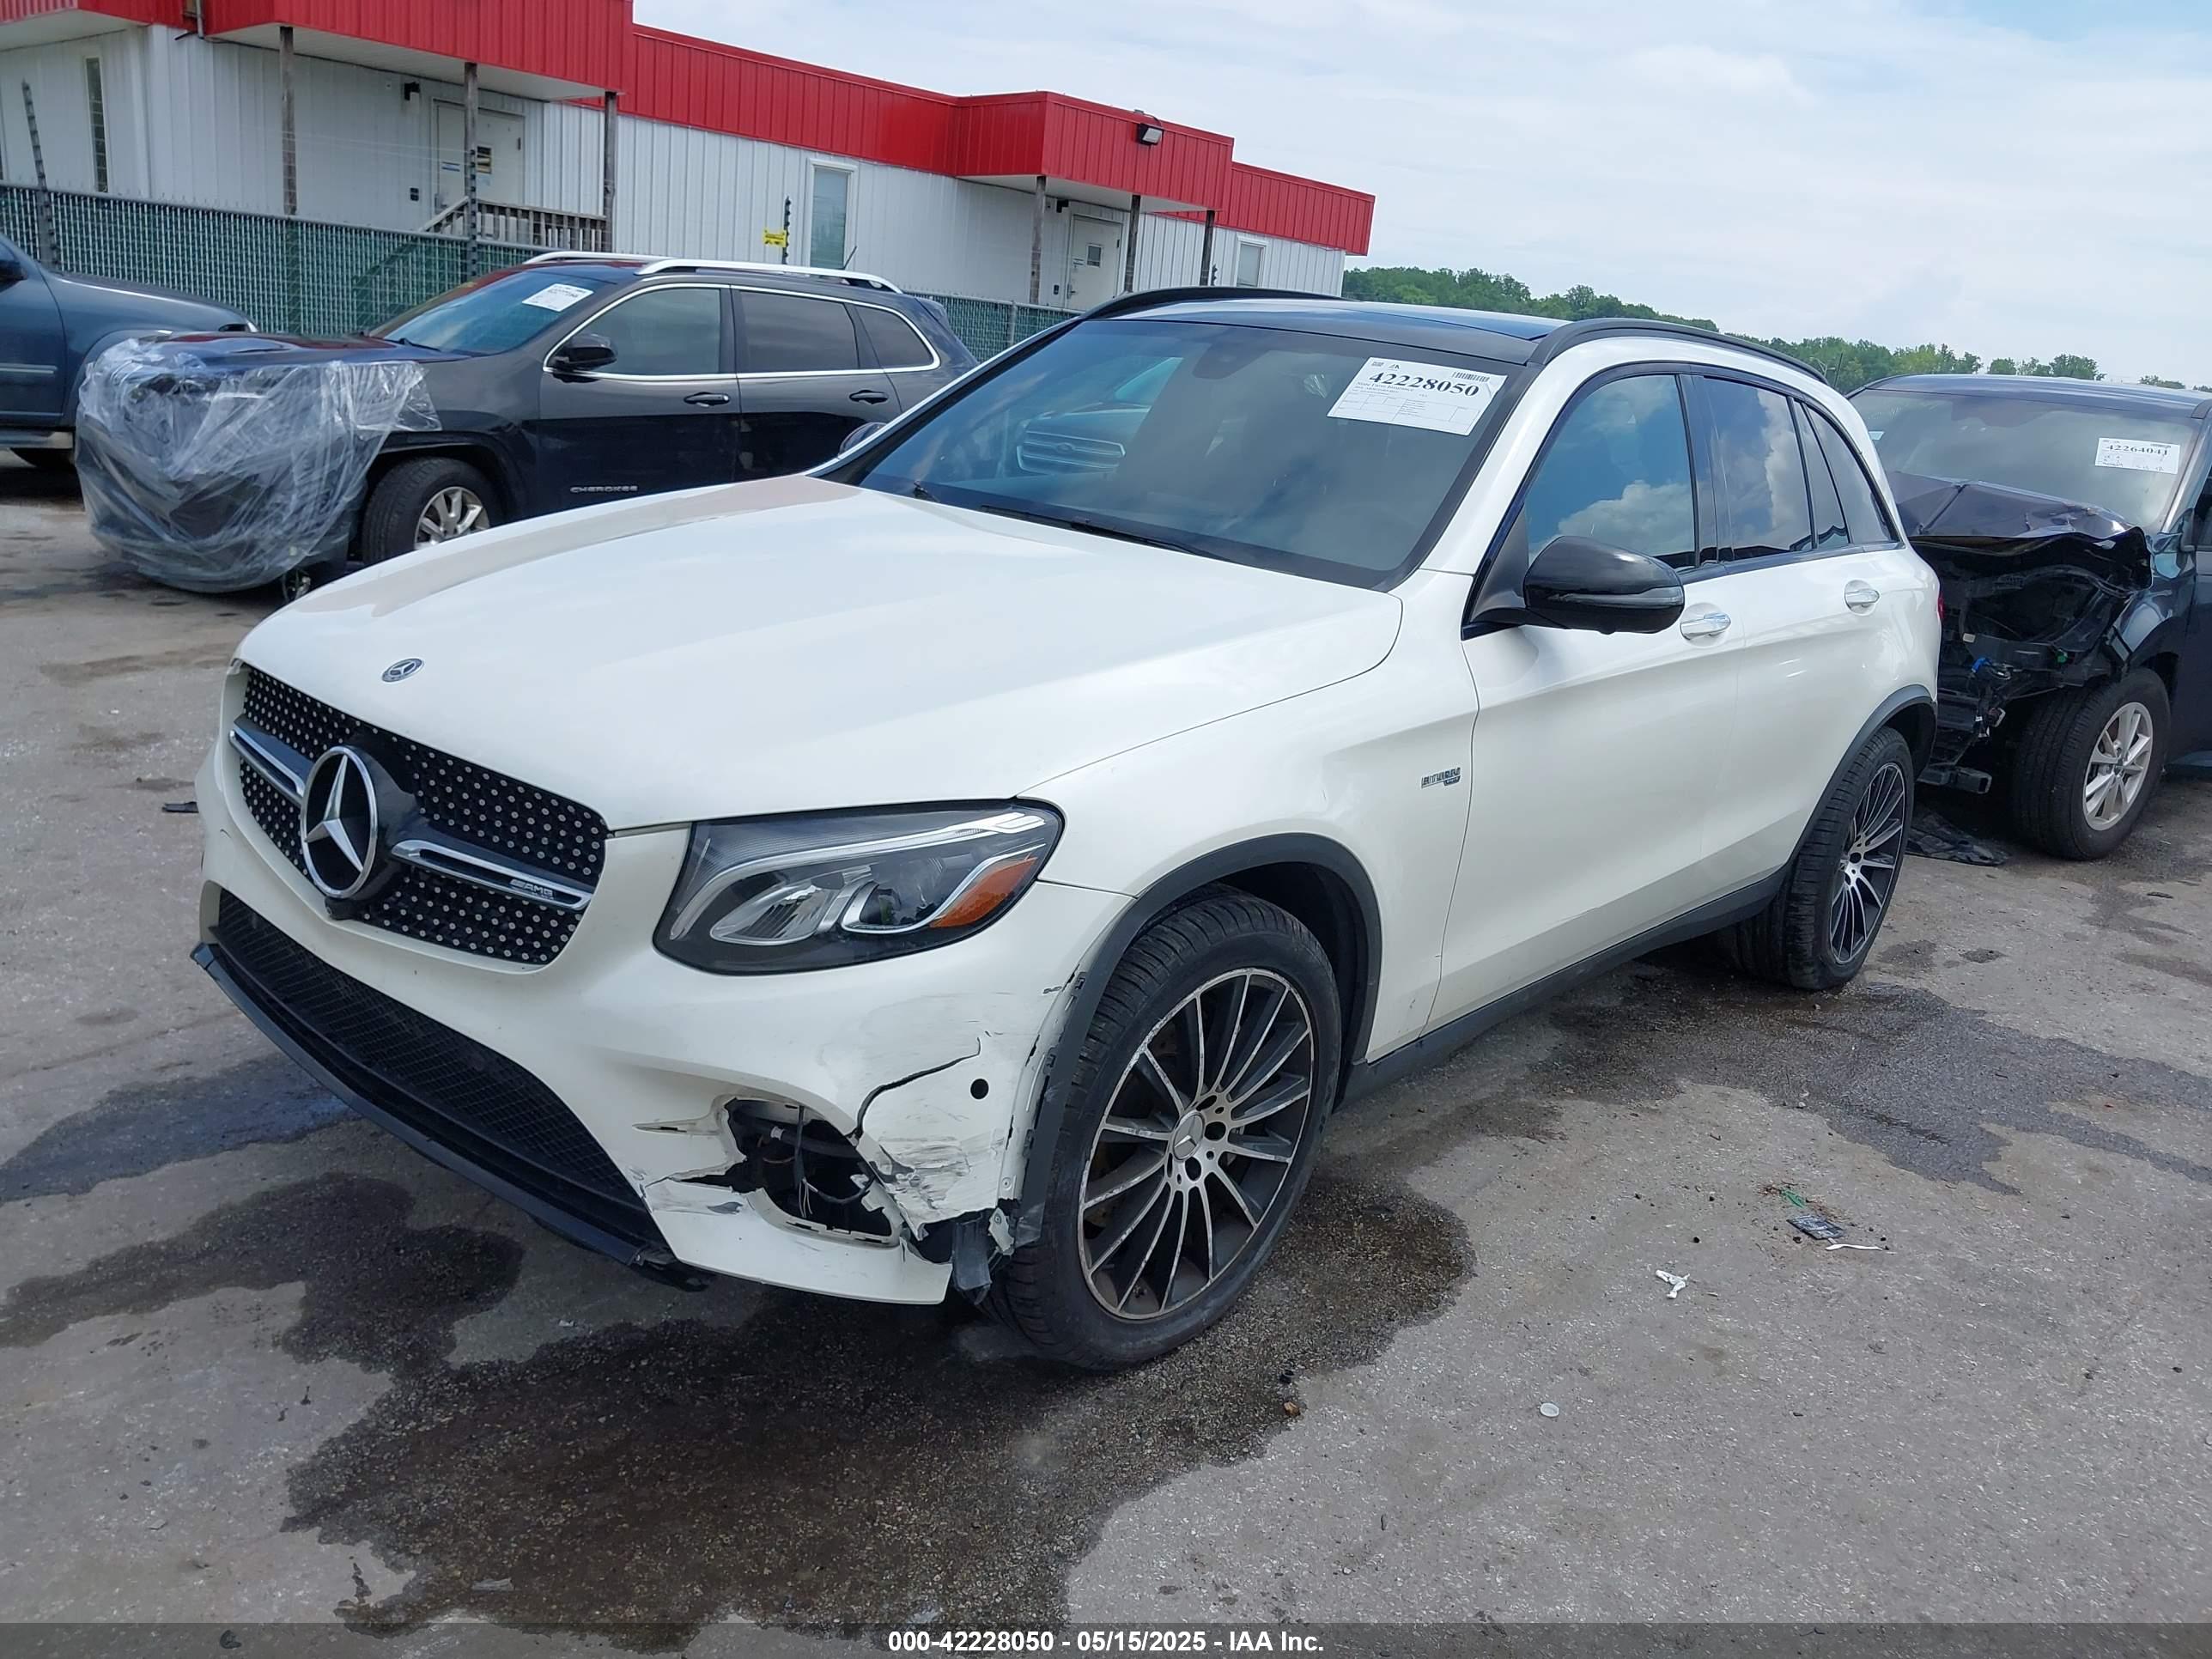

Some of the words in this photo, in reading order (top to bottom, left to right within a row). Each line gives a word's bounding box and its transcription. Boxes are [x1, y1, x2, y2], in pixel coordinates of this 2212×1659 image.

[1369, 372, 1480, 396] 42228050
[2107, 444, 2168, 456] 42264041
[569, 485, 638, 494] CHEROKEE
[524, 883, 553, 896] AMG
